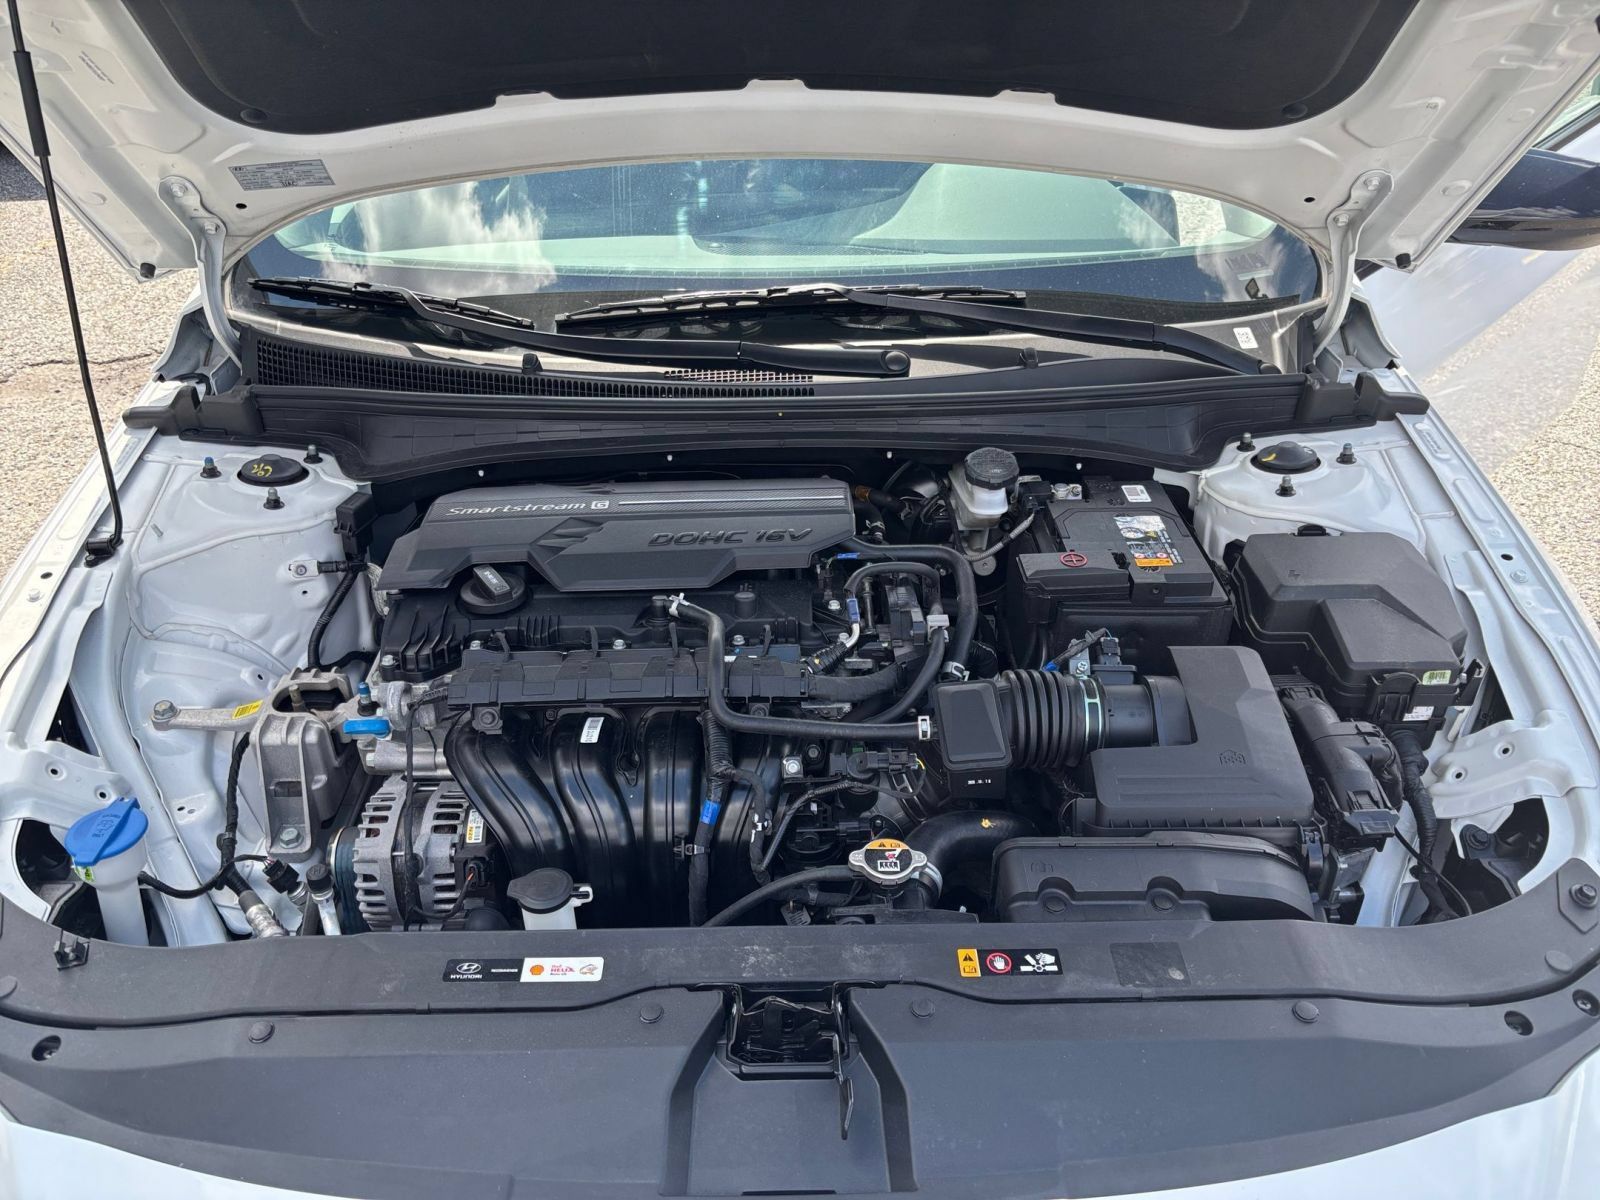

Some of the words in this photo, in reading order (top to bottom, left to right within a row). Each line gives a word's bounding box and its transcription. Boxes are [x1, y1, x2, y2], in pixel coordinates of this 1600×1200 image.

[446, 503, 586, 515] Smartstream
[648, 530, 748, 547] DOHC
[755, 528, 812, 543] 16V
